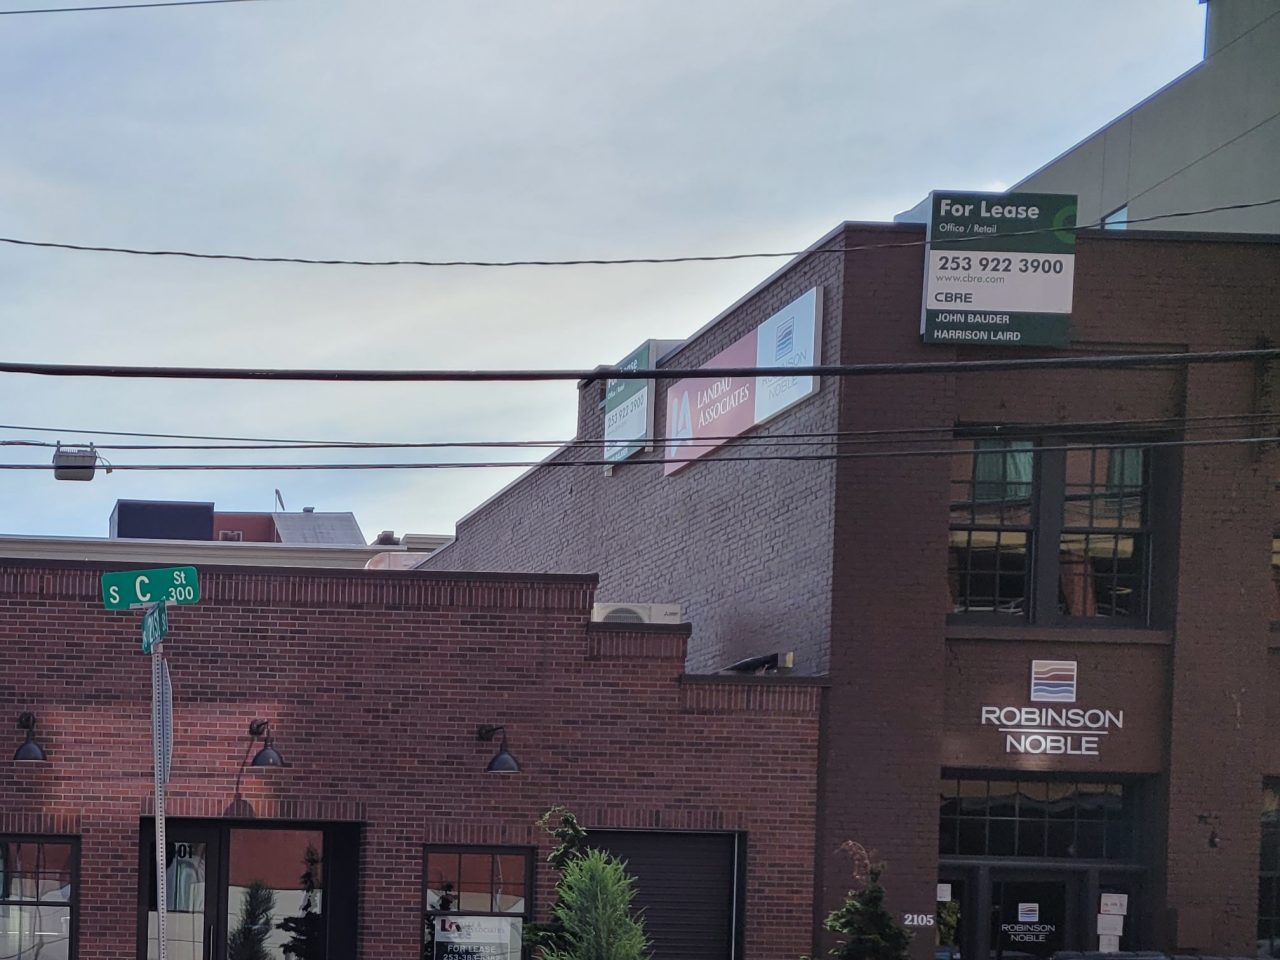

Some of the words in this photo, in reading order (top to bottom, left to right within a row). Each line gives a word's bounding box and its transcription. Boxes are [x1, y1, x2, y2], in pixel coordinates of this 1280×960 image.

[939, 200, 974, 217] For
[980, 201, 1040, 219] Lease
[939, 222, 965, 233] Office
[973, 224, 997, 233] Retail
[938, 256, 972, 271] 253
[978, 257, 1012, 272] 922
[1018, 259, 1064, 274] 3900
[935, 273, 1005, 284] www.cbre.com
[934, 292, 973, 304] CBRE
[935, 313, 965, 323] JOHN
[967, 314, 1010, 324] BAUDER
[933, 330, 988, 340] HARRISON
[990, 331, 1021, 341] LAIRD
[697, 376, 732, 409] LANDAU
[697, 383, 749, 429] ASSOCIATES
[109, 586, 120, 604] S
[135, 575, 151, 602] C
[173, 571, 186, 585] St
[168, 586, 194, 601] 300
[981, 706, 1124, 728] ROBINSON
[1006, 734, 1099, 755] NOBLE
[904, 913, 934, 926] 2105
[1001, 924, 1056, 932] ROBINSON
[1010, 934, 1046, 942] NOBLE
[447, 945, 466, 953] FOR
[468, 945, 496, 953] LEASE
